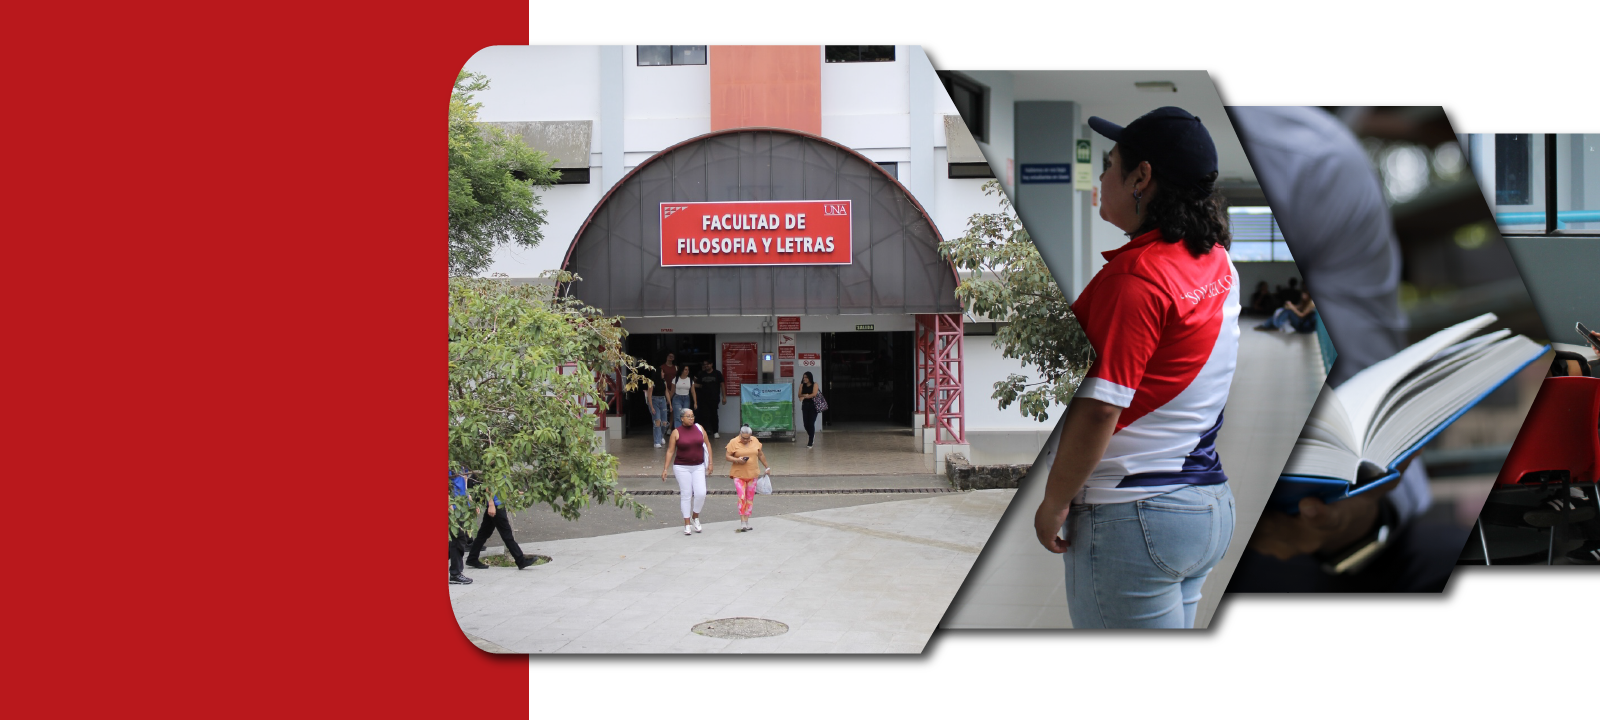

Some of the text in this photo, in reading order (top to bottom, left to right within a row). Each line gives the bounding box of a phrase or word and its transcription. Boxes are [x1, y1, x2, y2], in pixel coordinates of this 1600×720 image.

[824, 204, 847, 216] UNA
[702, 213, 806, 231] FACULTAD DE
[677, 236, 835, 254] FILOSOFIA Y LETRAS
